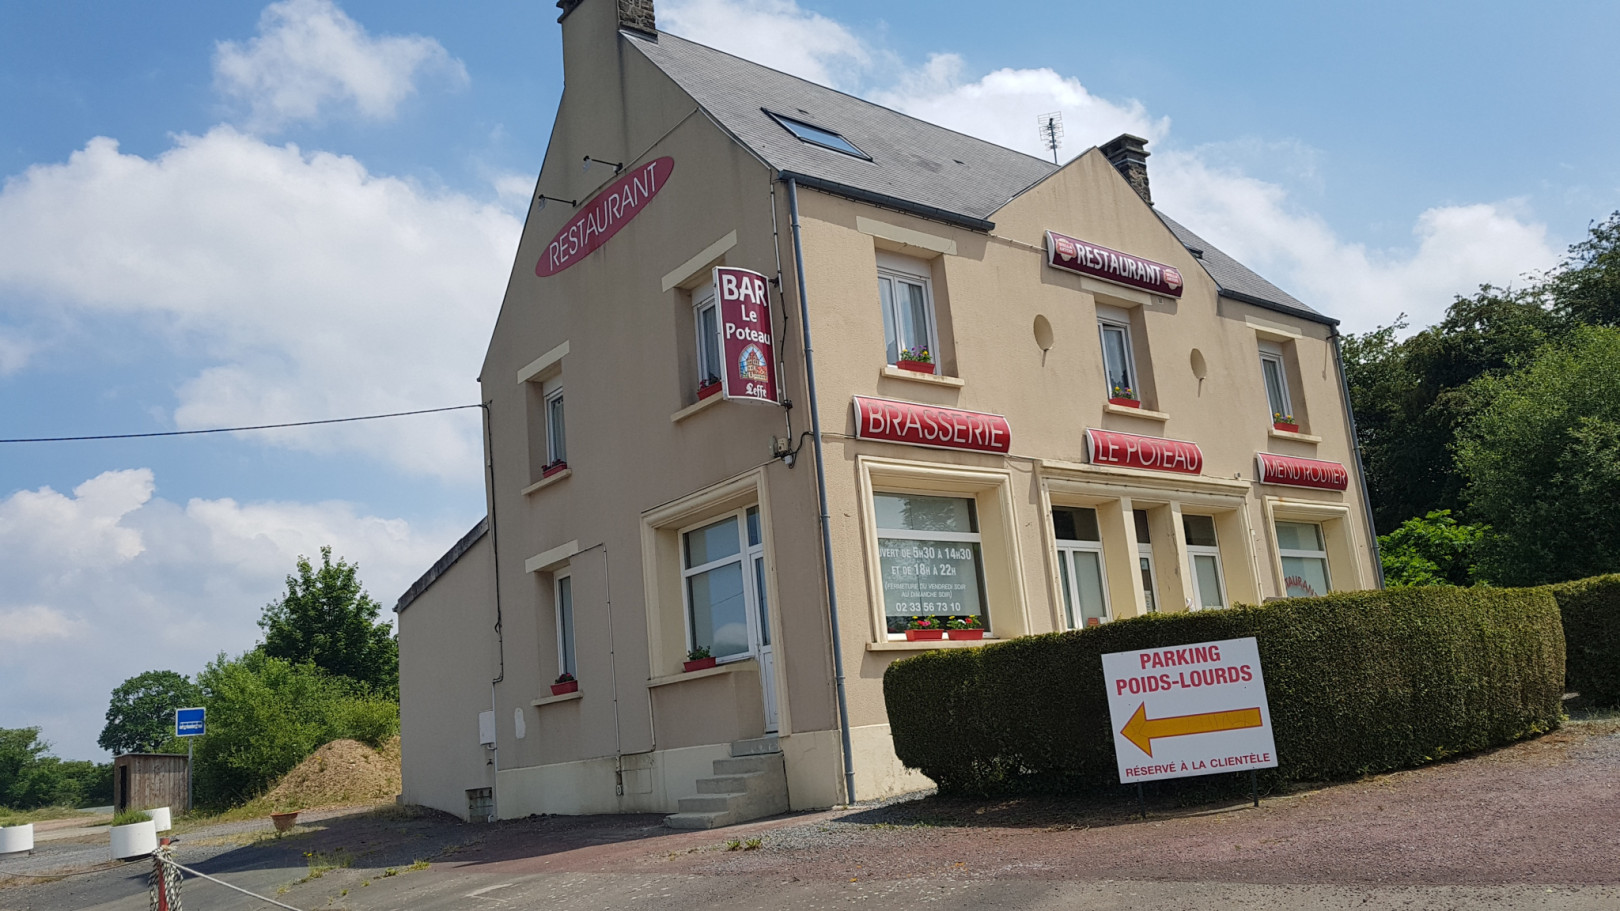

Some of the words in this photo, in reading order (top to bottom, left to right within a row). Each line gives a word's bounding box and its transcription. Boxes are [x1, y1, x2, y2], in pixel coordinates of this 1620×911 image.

[550, 162, 657, 271] RESTAURANT
[1075, 243, 1161, 285] RESTAURANT
[722, 274, 767, 306] BAR
[741, 304, 758, 322] Le
[725, 323, 771, 346] Poteau
[866, 402, 1004, 447] BRASSERIE
[1096, 433, 1120, 462] LE
[1124, 438, 1199, 471] POTEAU
[1264, 458, 1301, 480] MENU
[1302, 463, 1346, 485] ROUTIER
[901, 549, 911, 558] DE
[891, 566, 900, 575] ET
[902, 566, 912, 575] DE
[895, 602, 908, 612] 02
[909, 602, 921, 612] 33
[923, 602, 935, 612] 56
[936, 602, 948, 612] 73
[950, 602, 961, 612] 10
[1139, 645, 1221, 670] PARKING
[1115, 664, 1253, 696] POIDS-LOURDS
[1125, 761, 1177, 777] RÉSERVÉ
[1180, 760, 1189, 772] À
[1191, 760, 1206, 770] LA
[1210, 752, 1271, 768] CLIENTÈLE
